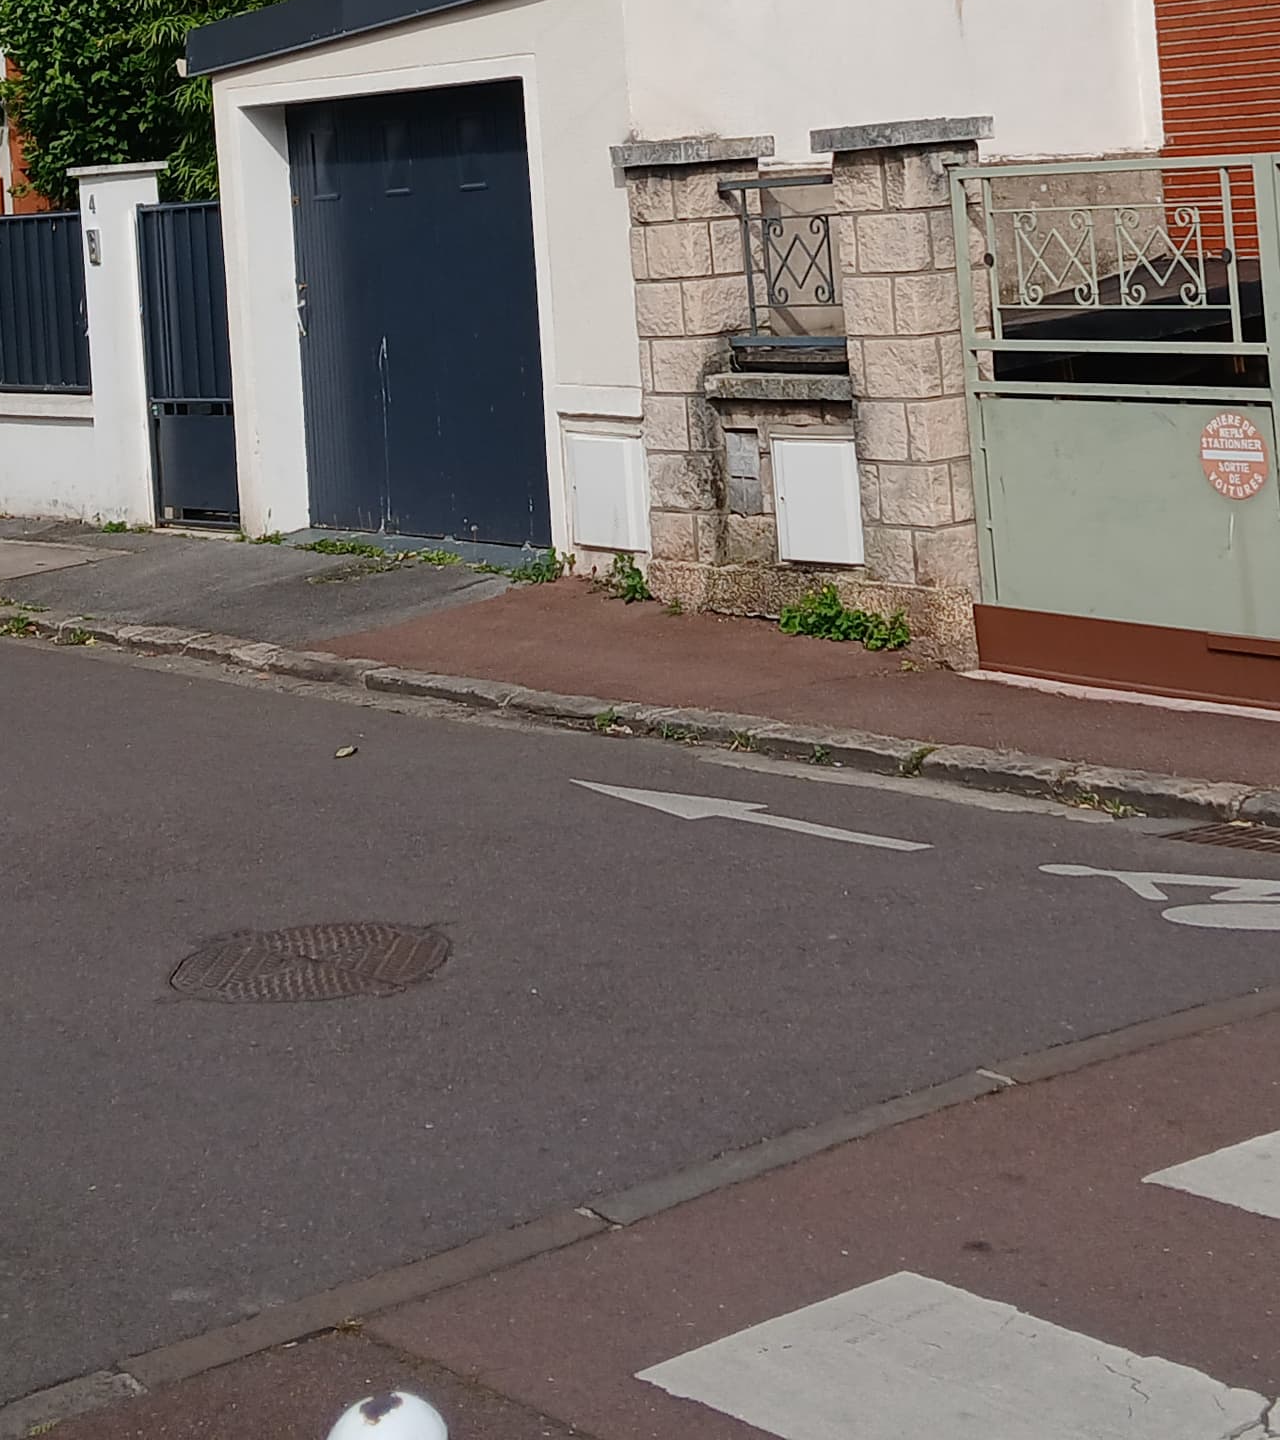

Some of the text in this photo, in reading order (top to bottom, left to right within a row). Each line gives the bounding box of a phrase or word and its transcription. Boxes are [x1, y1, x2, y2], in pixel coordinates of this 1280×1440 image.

[89, 194, 96, 214] 4
[1242, 420, 1256, 436] DE
[1202, 438, 1261, 450] STATIONNER
[1218, 462, 1250, 473] SORTIE
[1209, 472, 1263, 496] VOITURES
[1228, 474, 1241, 484] DE
